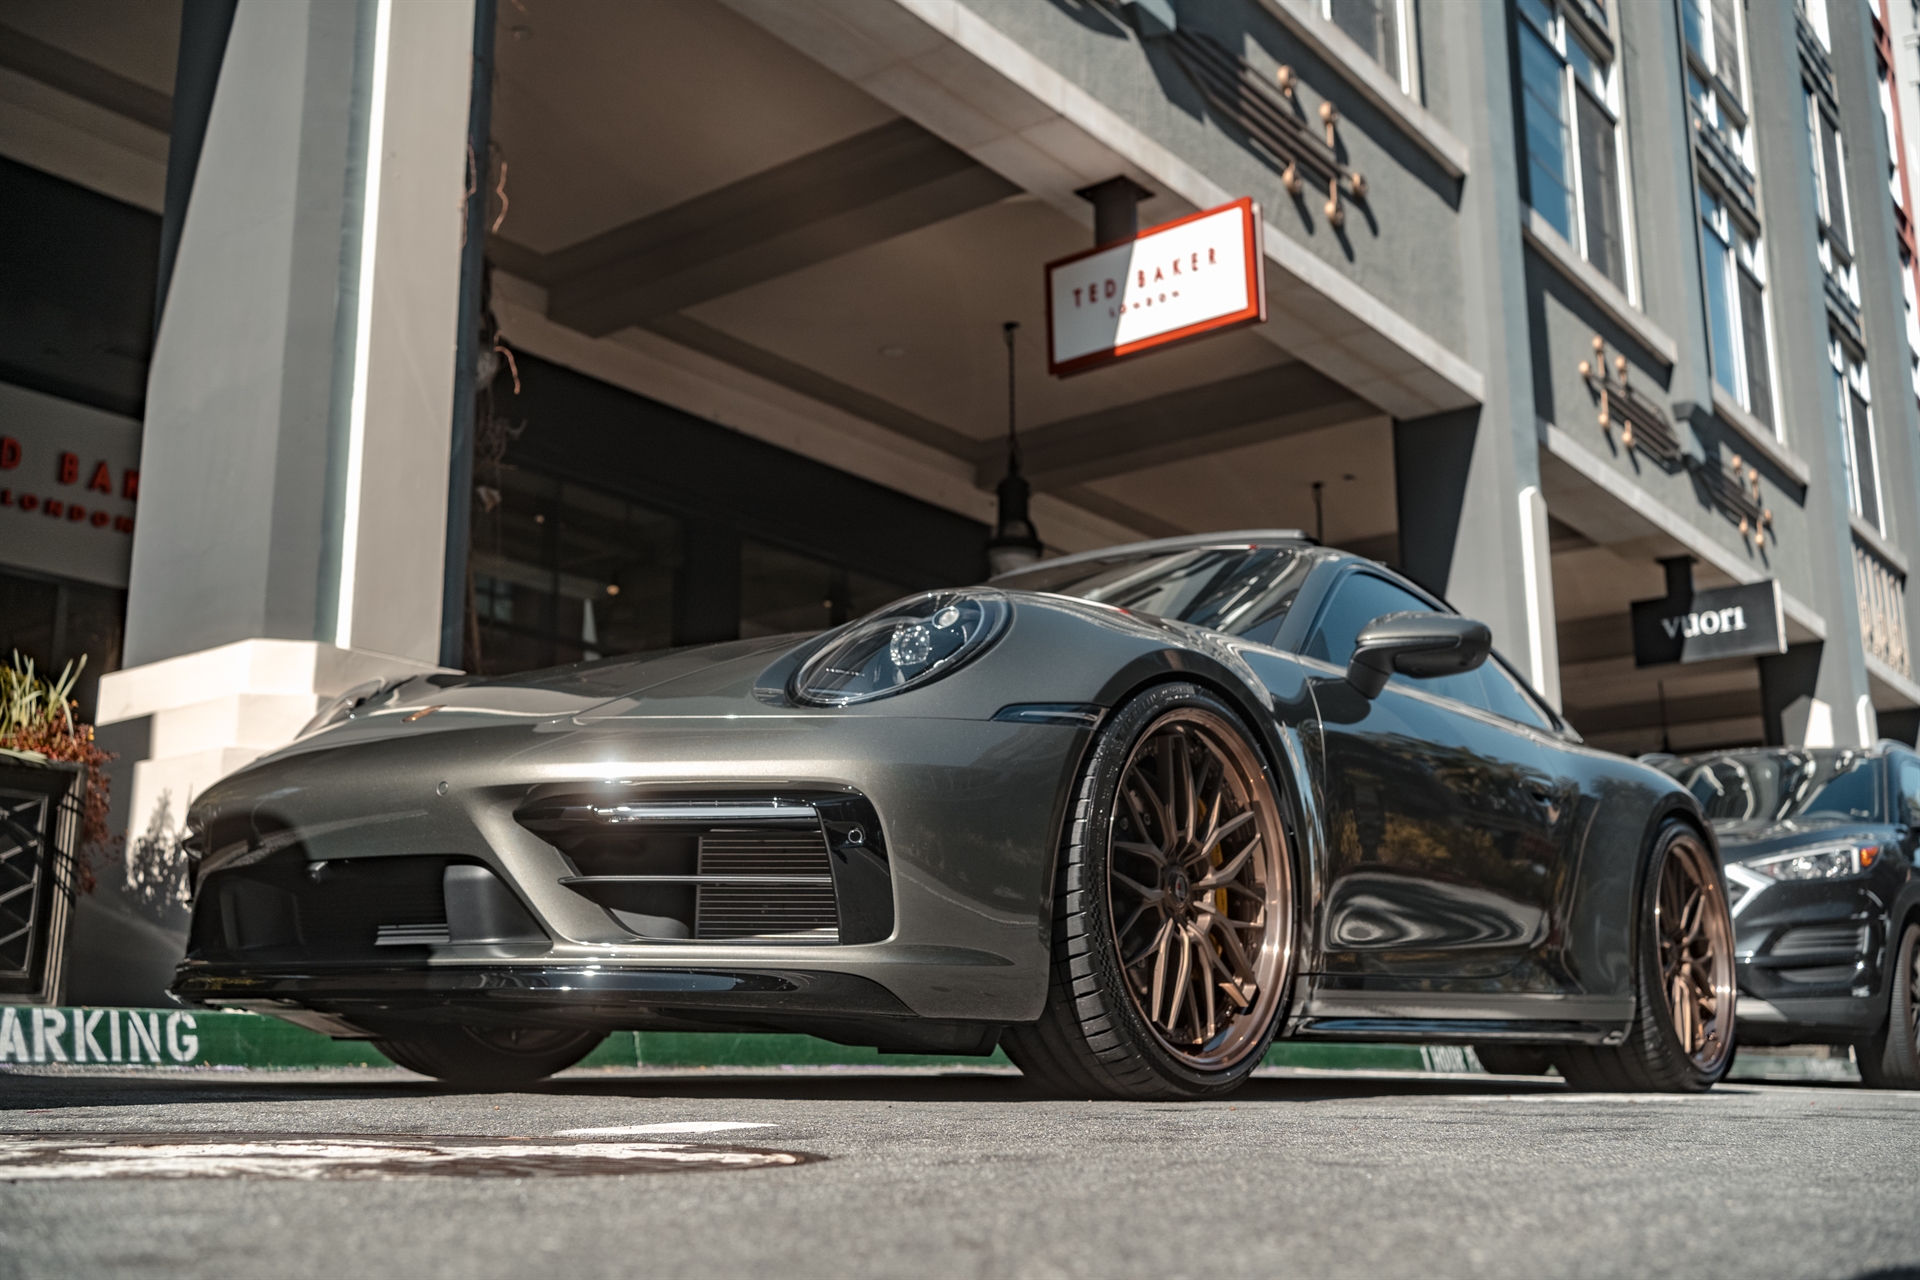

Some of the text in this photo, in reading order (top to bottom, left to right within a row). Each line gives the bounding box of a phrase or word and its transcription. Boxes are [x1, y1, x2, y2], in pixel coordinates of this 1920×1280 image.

[1073, 248, 1217, 308] TED BAKER
[1, 489, 135, 534] LONDON
[1661, 605, 1747, 640] vuori
[0, 1007, 199, 1062] ARKING
